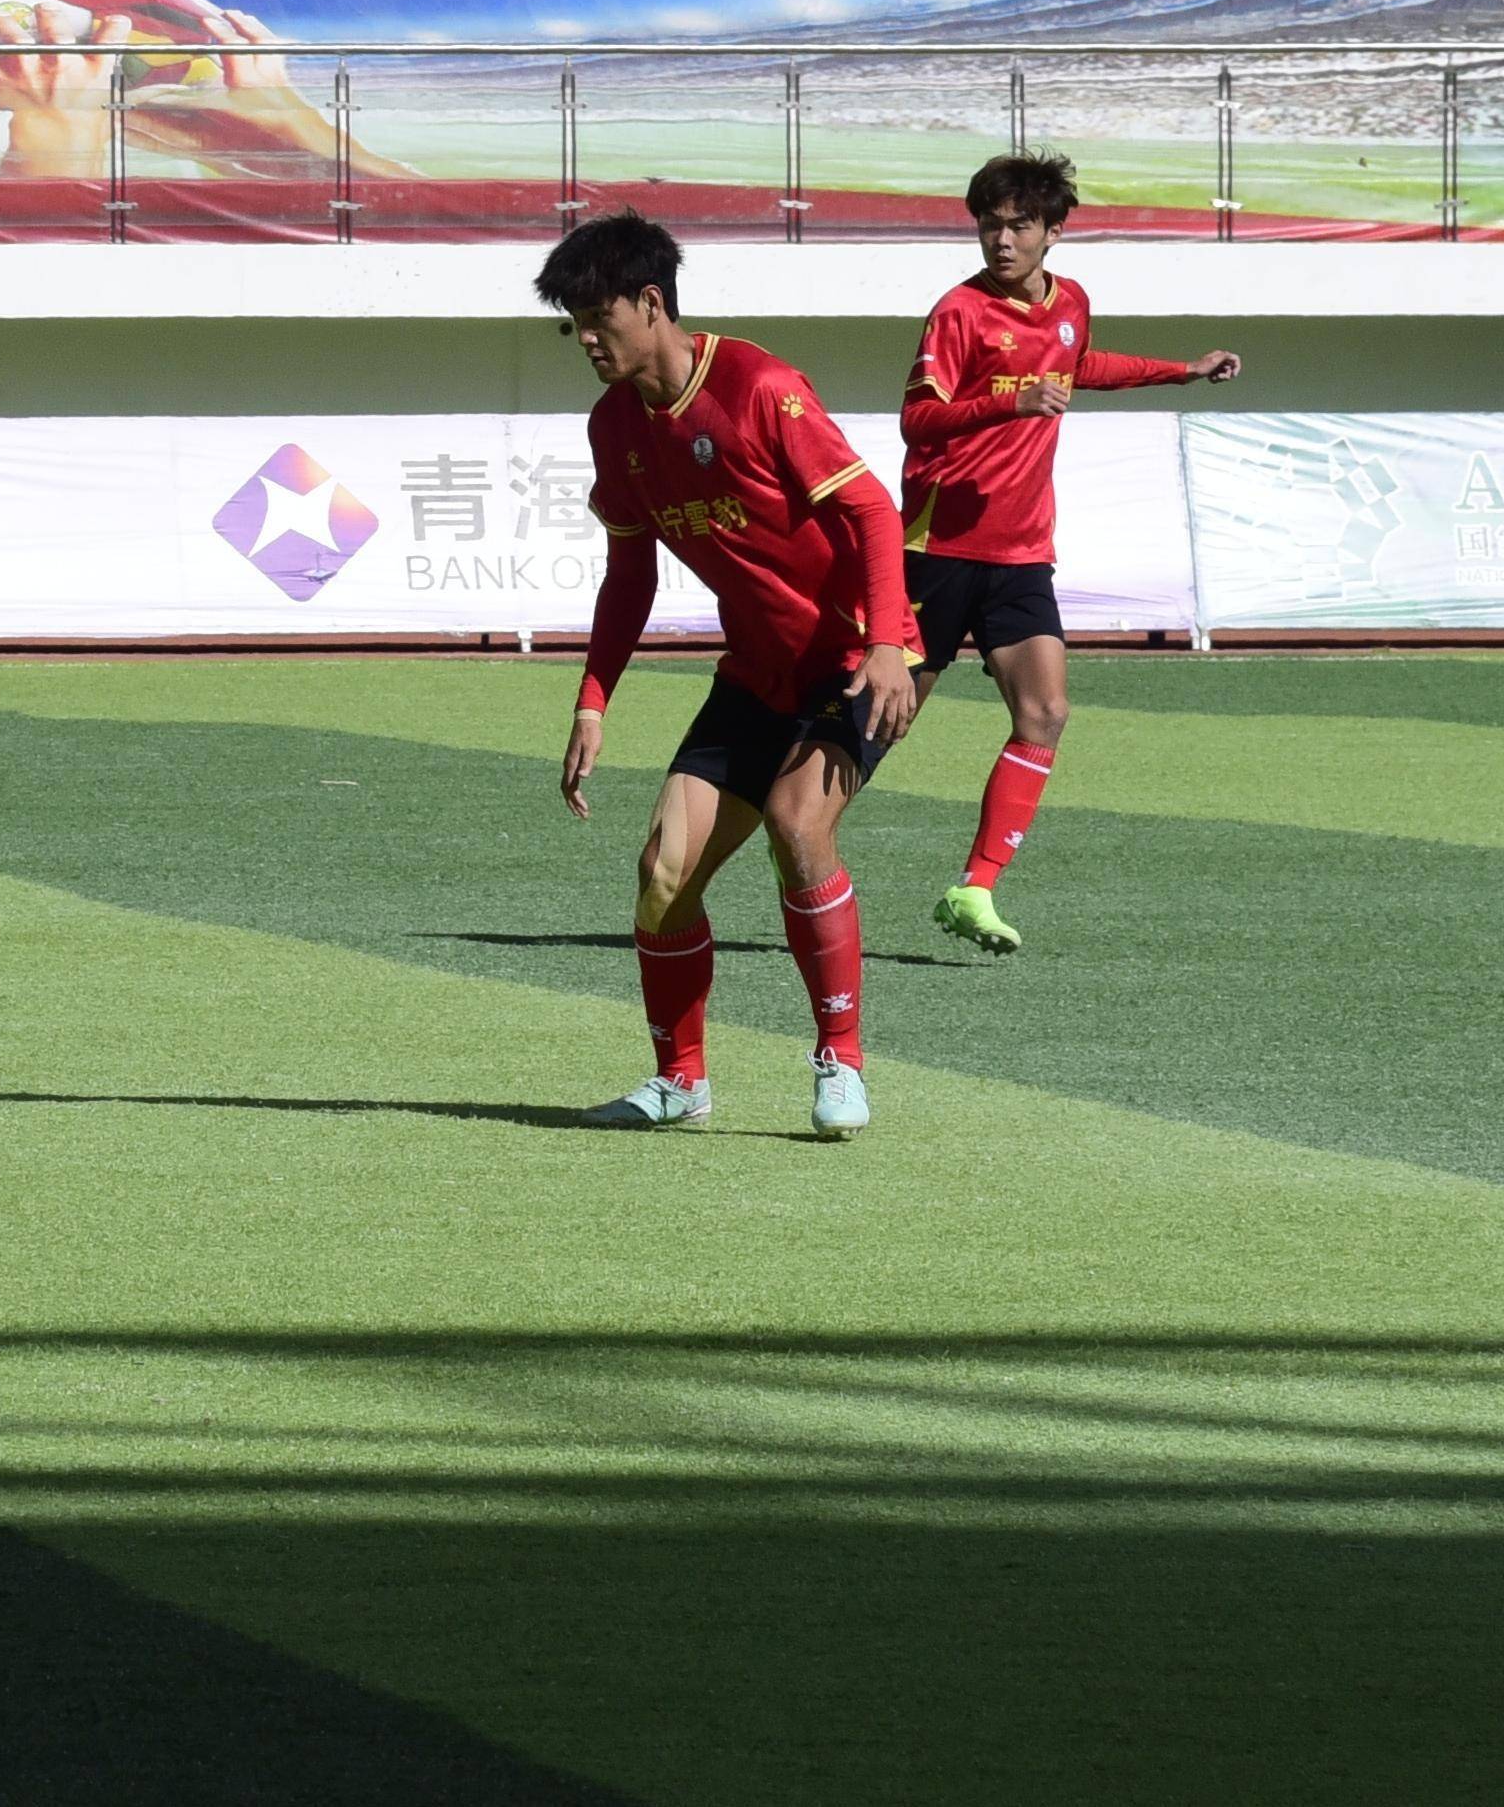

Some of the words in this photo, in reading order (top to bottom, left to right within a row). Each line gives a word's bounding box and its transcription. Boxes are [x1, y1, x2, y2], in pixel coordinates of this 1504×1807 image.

[649, 495, 749, 541] 宁雪豹
[405, 555, 540, 591] BANK
